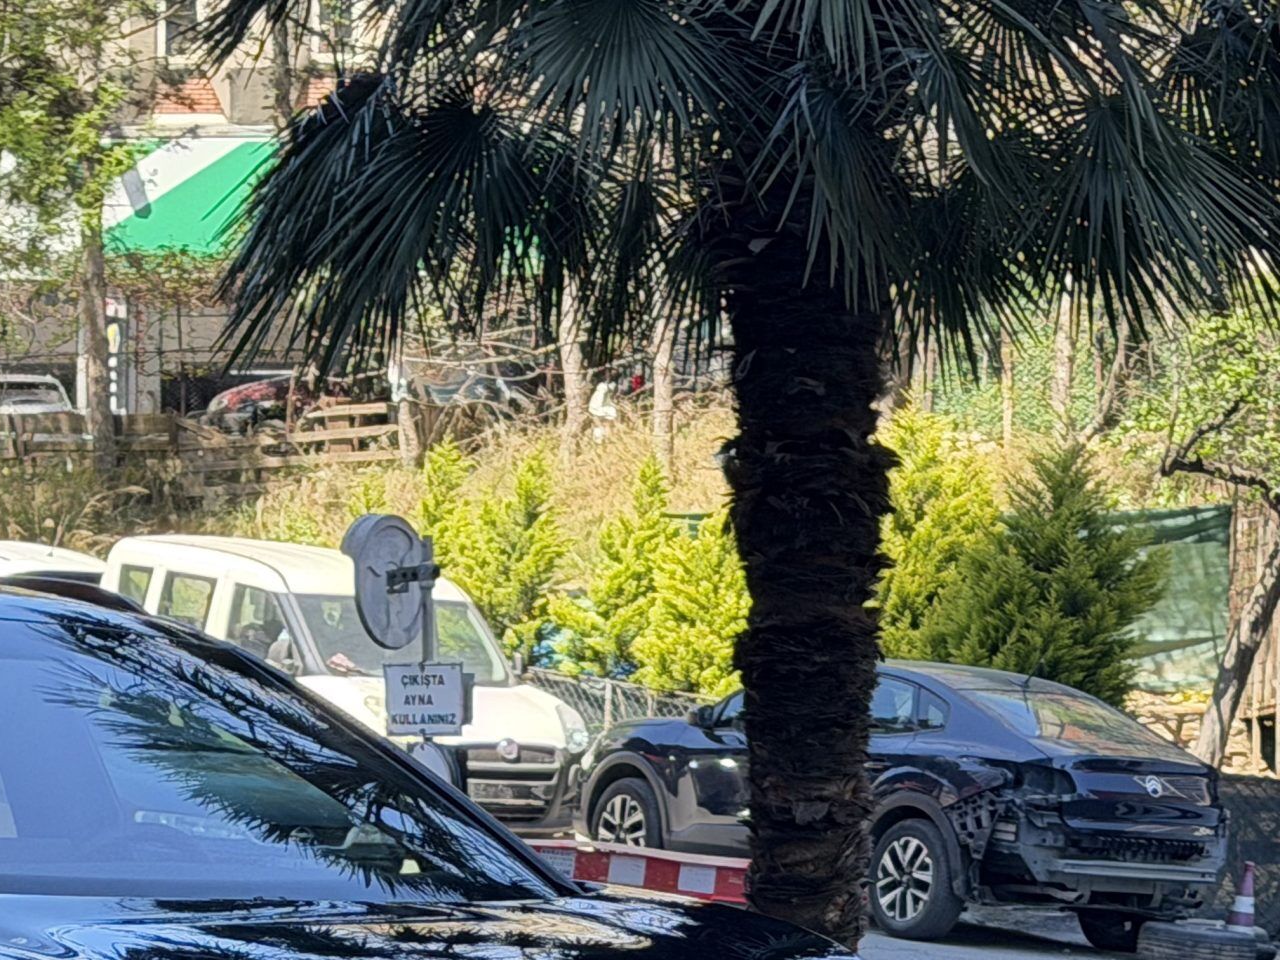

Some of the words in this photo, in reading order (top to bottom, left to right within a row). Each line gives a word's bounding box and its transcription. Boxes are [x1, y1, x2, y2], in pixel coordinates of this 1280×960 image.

[401, 674, 445, 689] ÇIKIŞTA
[404, 694, 434, 706] AYNA
[391, 713, 457, 725] KULLANINIZ
